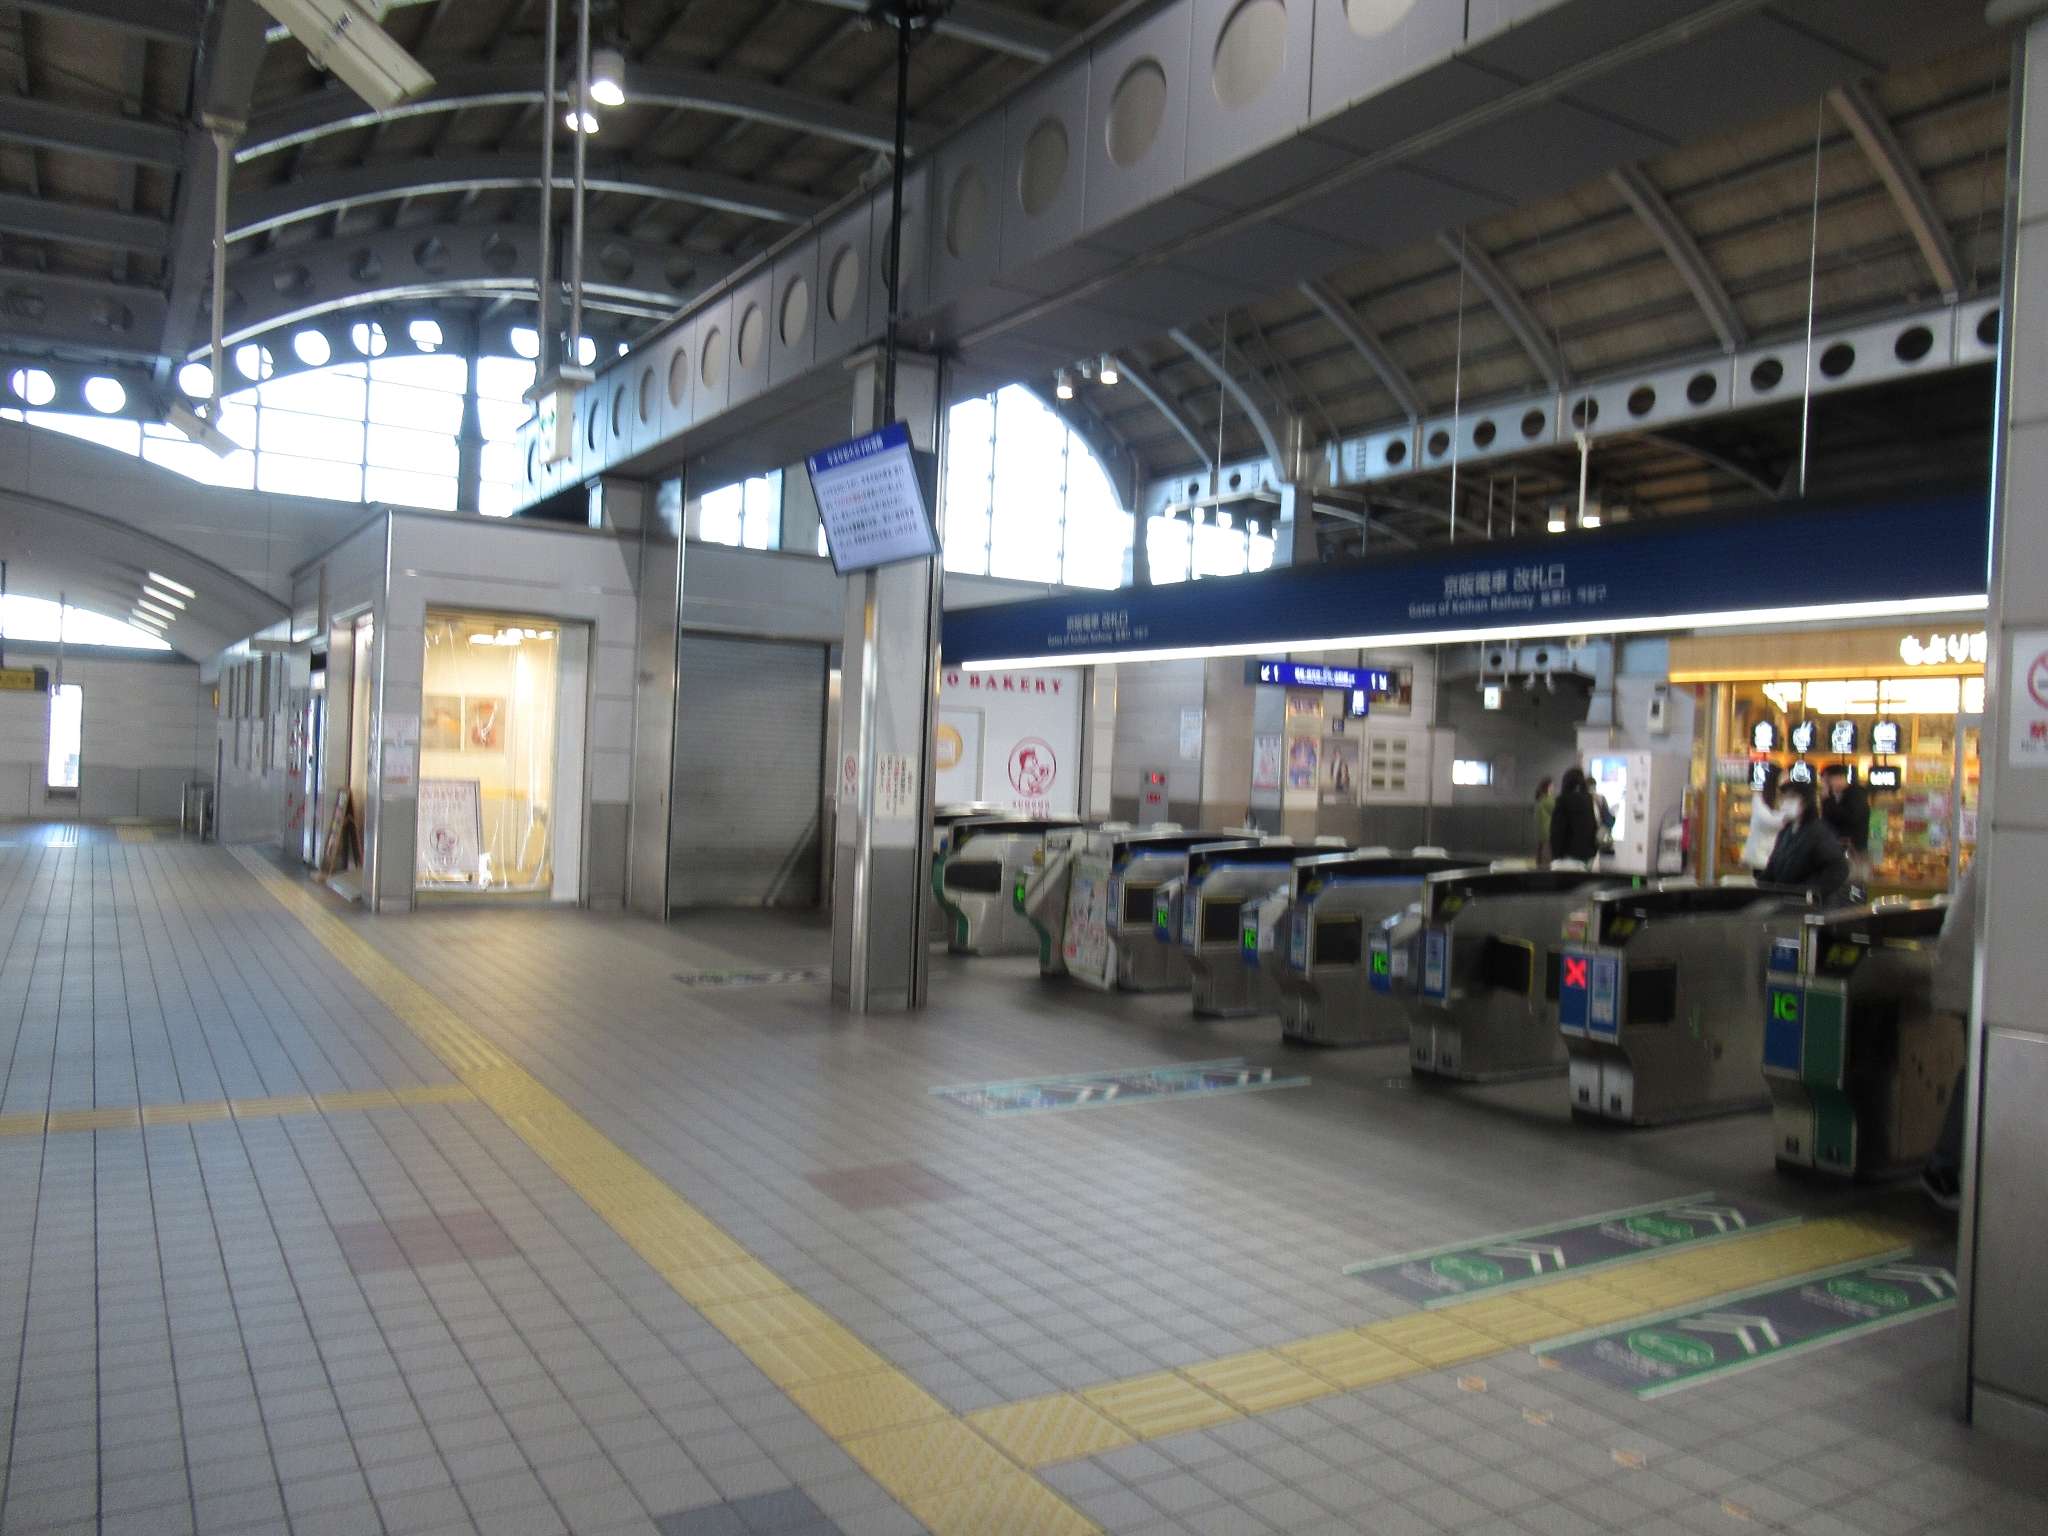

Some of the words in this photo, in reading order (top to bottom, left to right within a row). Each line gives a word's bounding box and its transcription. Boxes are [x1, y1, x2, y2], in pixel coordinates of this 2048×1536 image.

[1513, 564, 1565, 592] 改札口
[1438, 601, 1449, 616] of
[1491, 594, 1534, 611] Railway
[970, 673, 1062, 695] BAKERY
[1774, 992, 1797, 1021] IC
